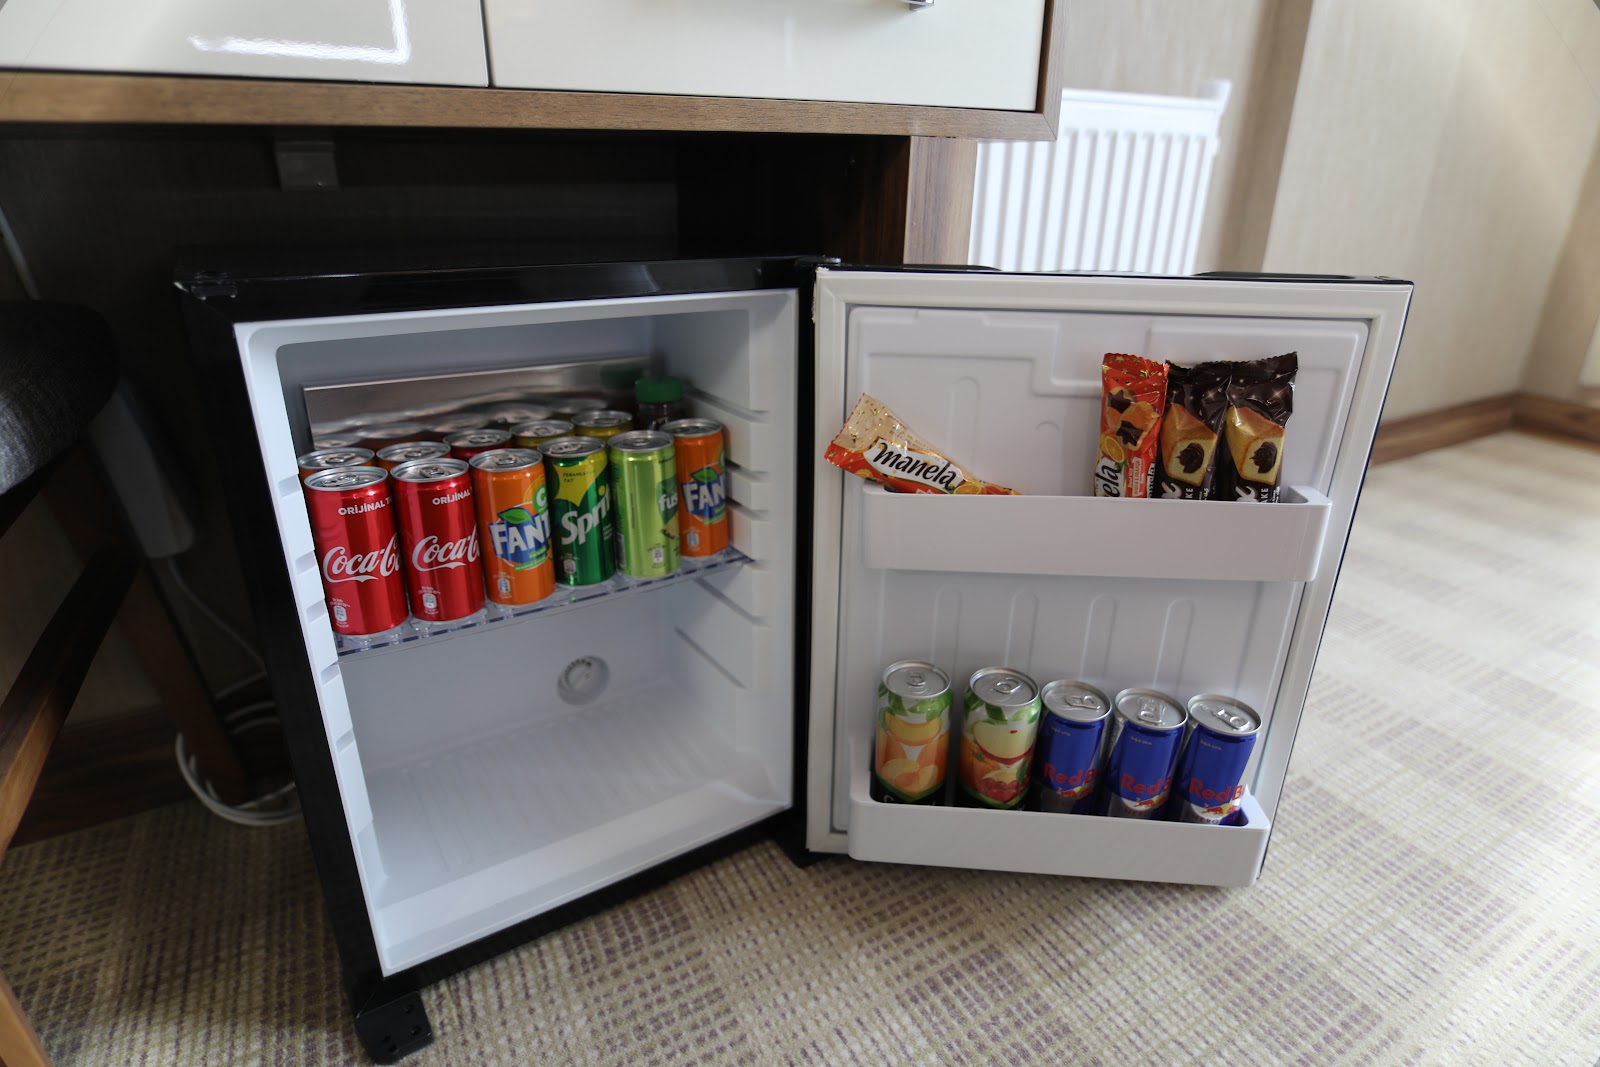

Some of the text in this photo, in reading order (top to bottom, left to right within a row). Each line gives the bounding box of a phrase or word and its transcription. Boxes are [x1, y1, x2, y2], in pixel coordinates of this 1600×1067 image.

[872, 442, 957, 489] manela
[338, 500, 386, 515] ORİJİNAL
[1043, 762, 1083, 785] Red
[1121, 773, 1161, 796] Red
[1188, 777, 1232, 802] Red
